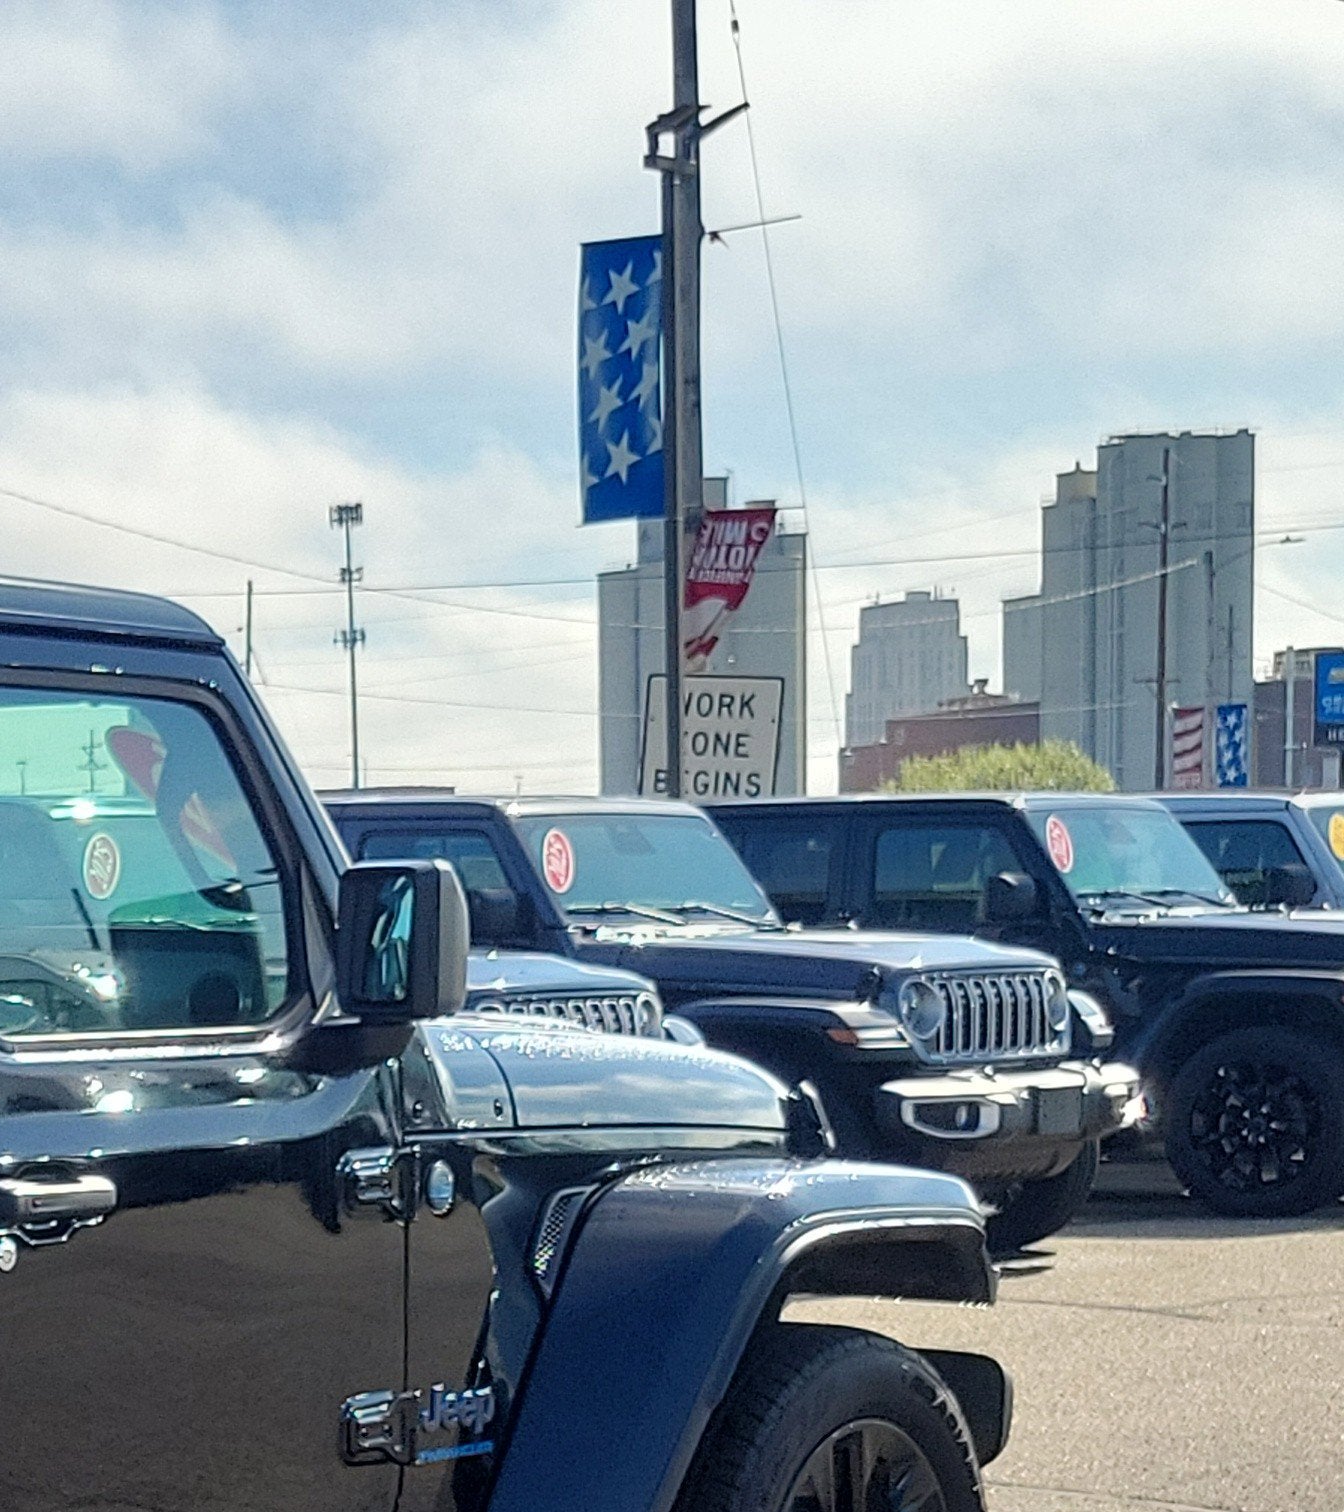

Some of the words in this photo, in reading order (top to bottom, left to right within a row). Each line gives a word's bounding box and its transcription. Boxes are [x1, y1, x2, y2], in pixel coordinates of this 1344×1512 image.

[683, 730, 750, 758] ONE
[653, 768, 761, 797] BGINS
[420, 1383, 495, 1435] Jeep
